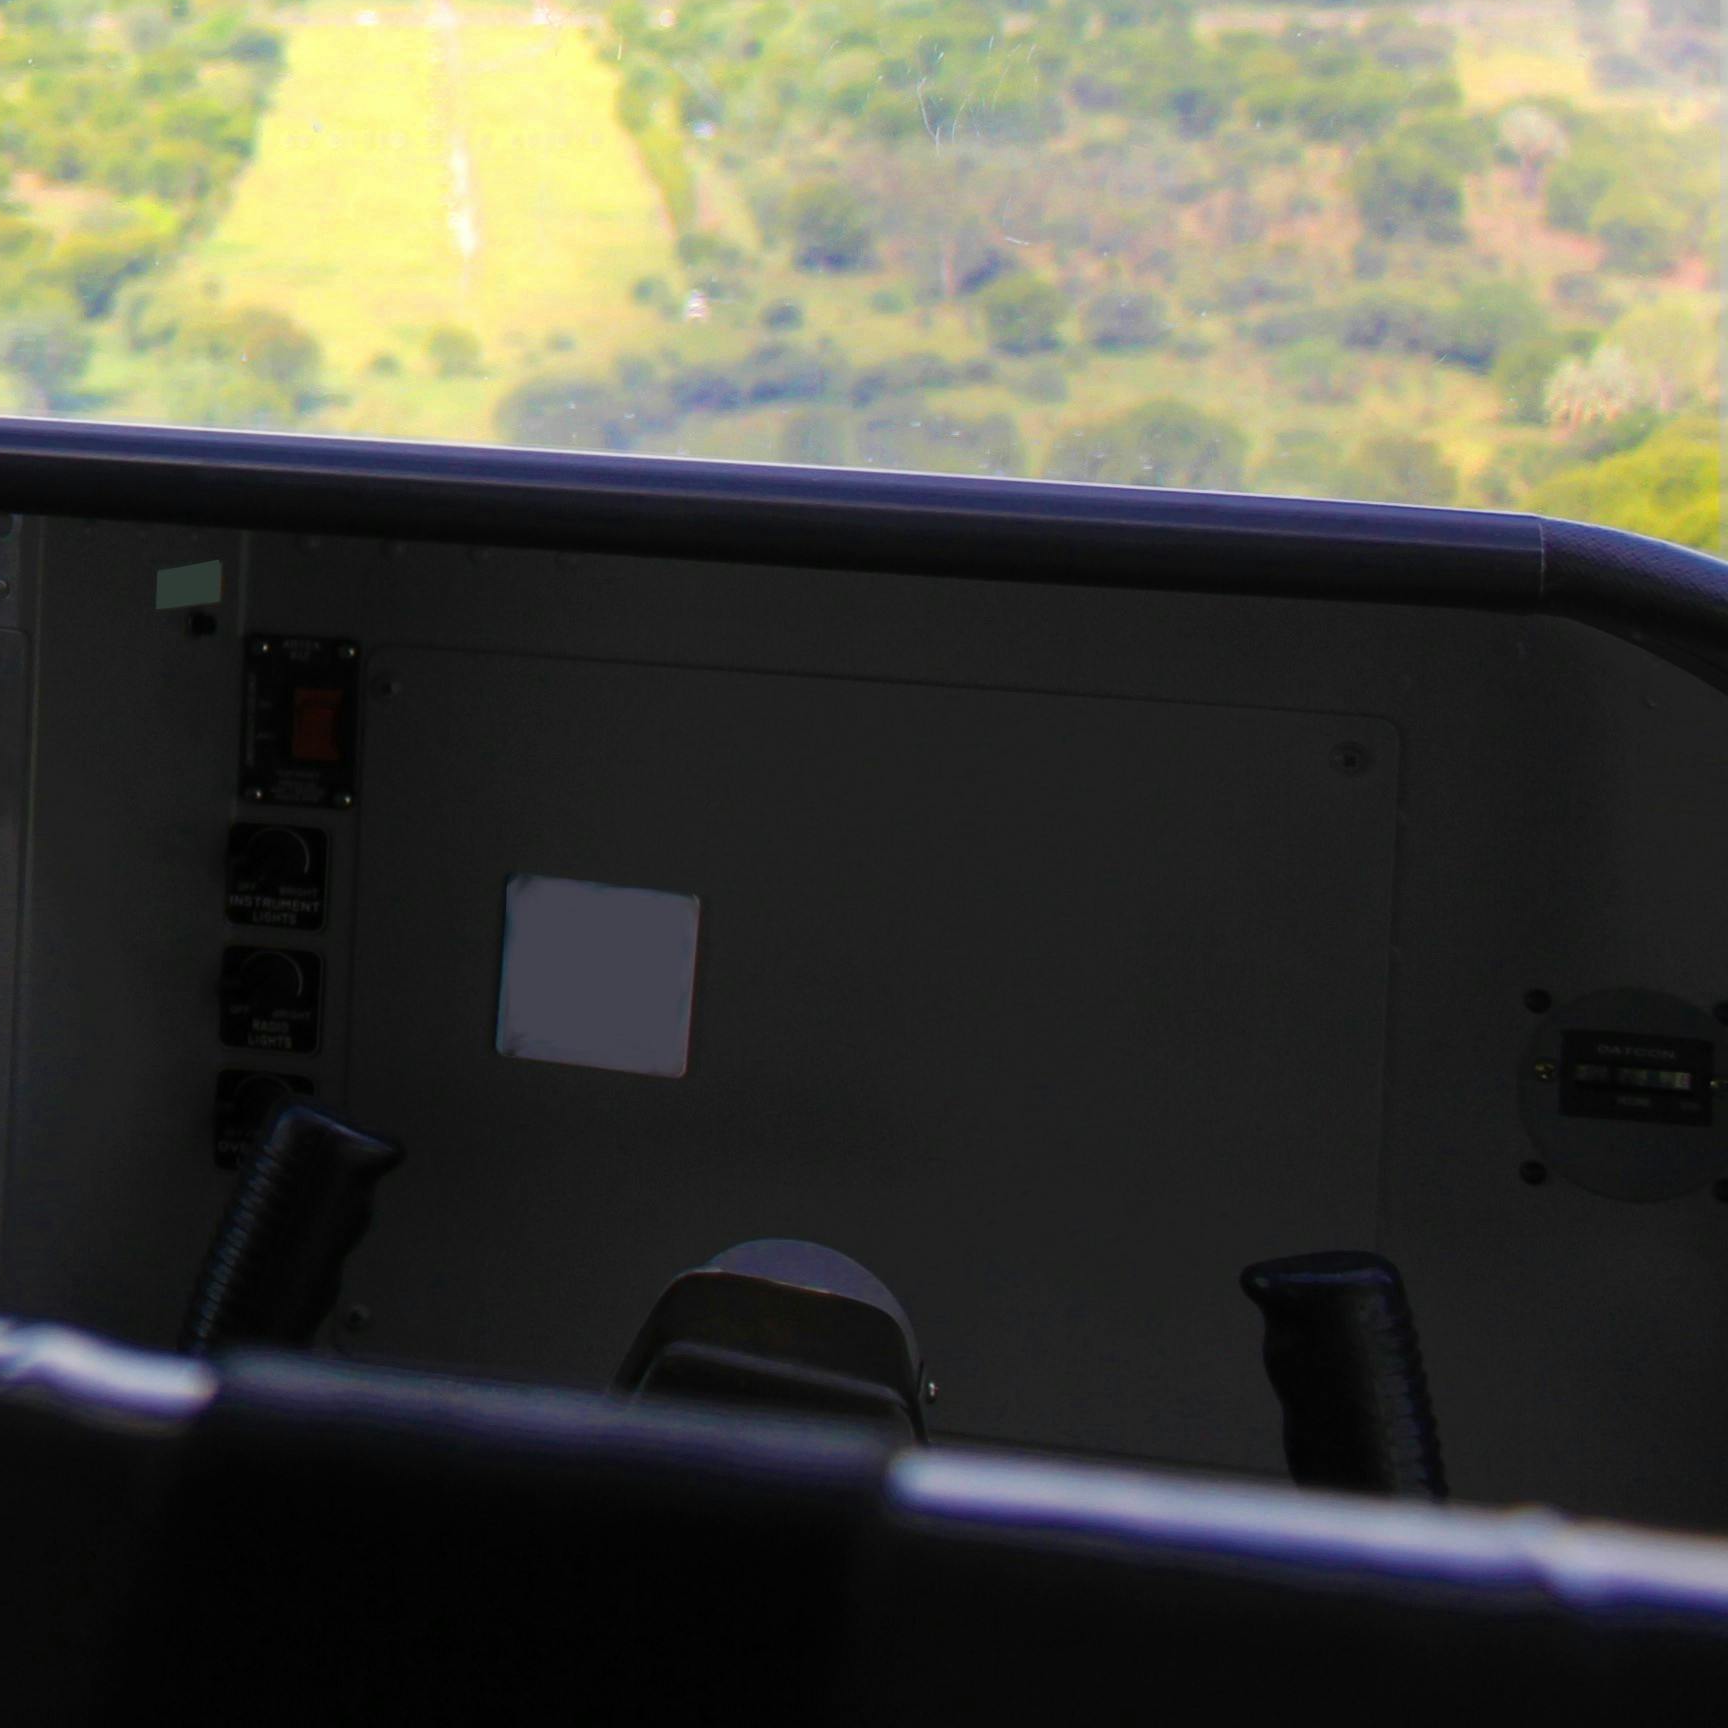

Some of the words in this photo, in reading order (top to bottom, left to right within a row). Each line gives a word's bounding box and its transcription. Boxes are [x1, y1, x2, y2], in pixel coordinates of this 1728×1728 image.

[228, 894, 321, 913] INSTRUMENT
[251, 912, 298, 926] LIGHTS
[251, 1017, 291, 1033] RADIO
[247, 1032, 293, 1049] LIGHTS
[1597, 1043, 1678, 1061] DATCON
